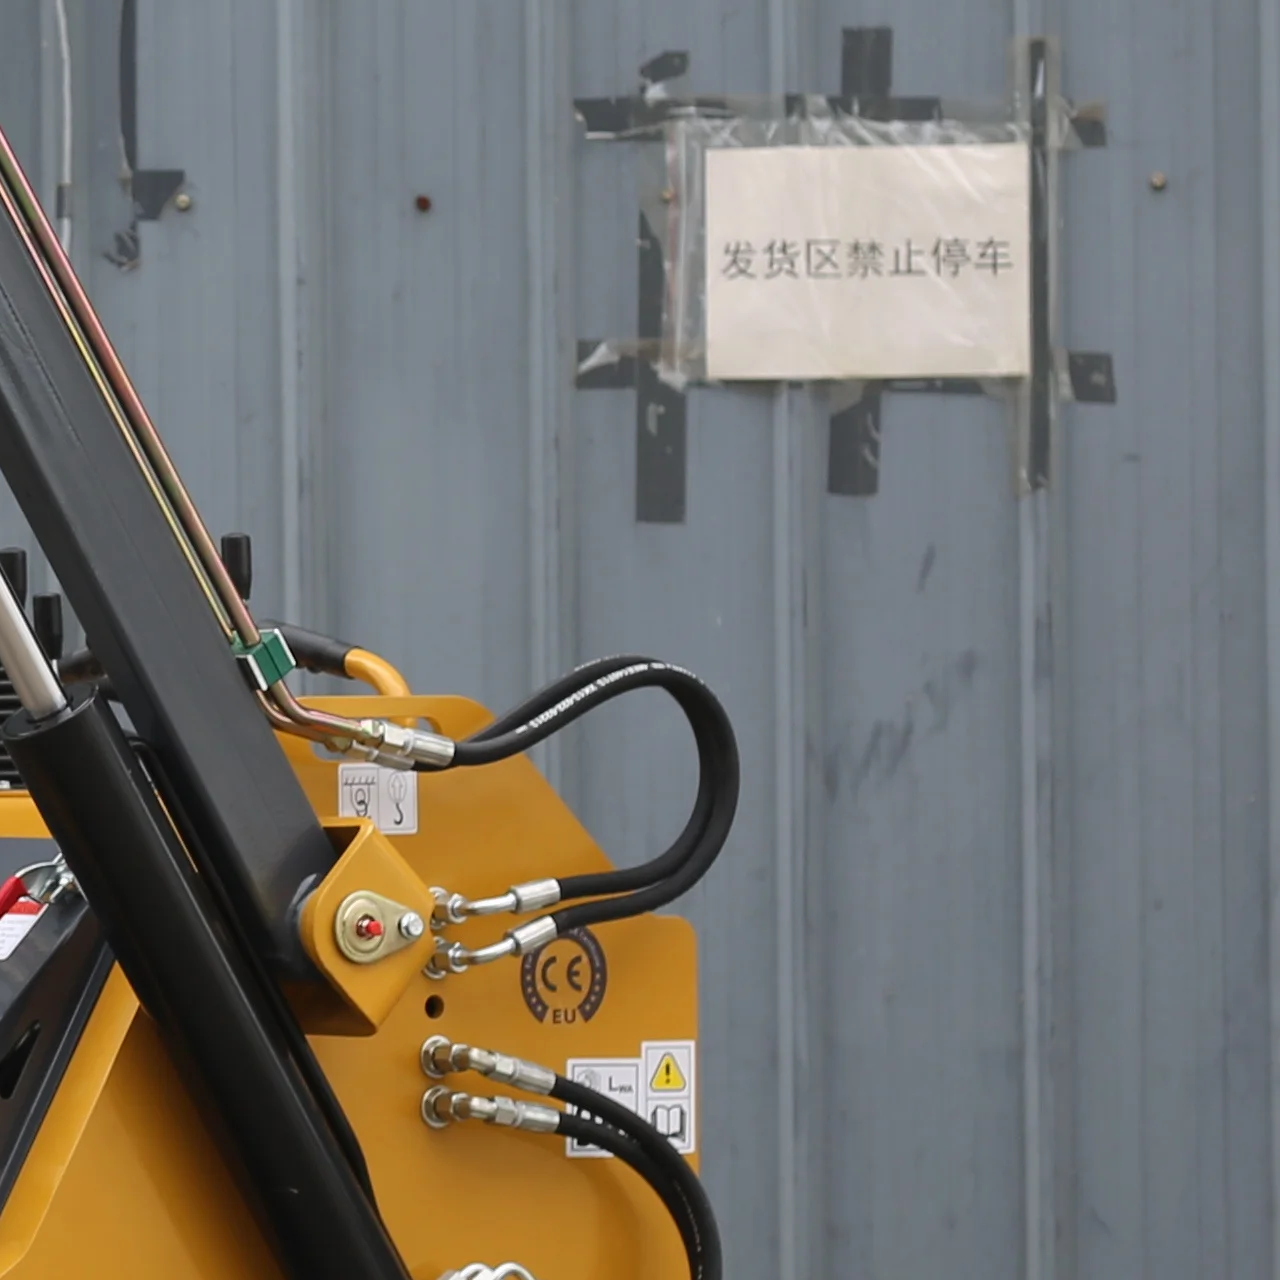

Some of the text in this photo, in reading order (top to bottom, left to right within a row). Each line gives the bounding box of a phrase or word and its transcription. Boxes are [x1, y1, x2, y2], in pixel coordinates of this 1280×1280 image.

[721, 236, 1014, 281] 发货区禁止停车
[541, 955, 583, 993] CE
[552, 1008, 577, 1024] EU
